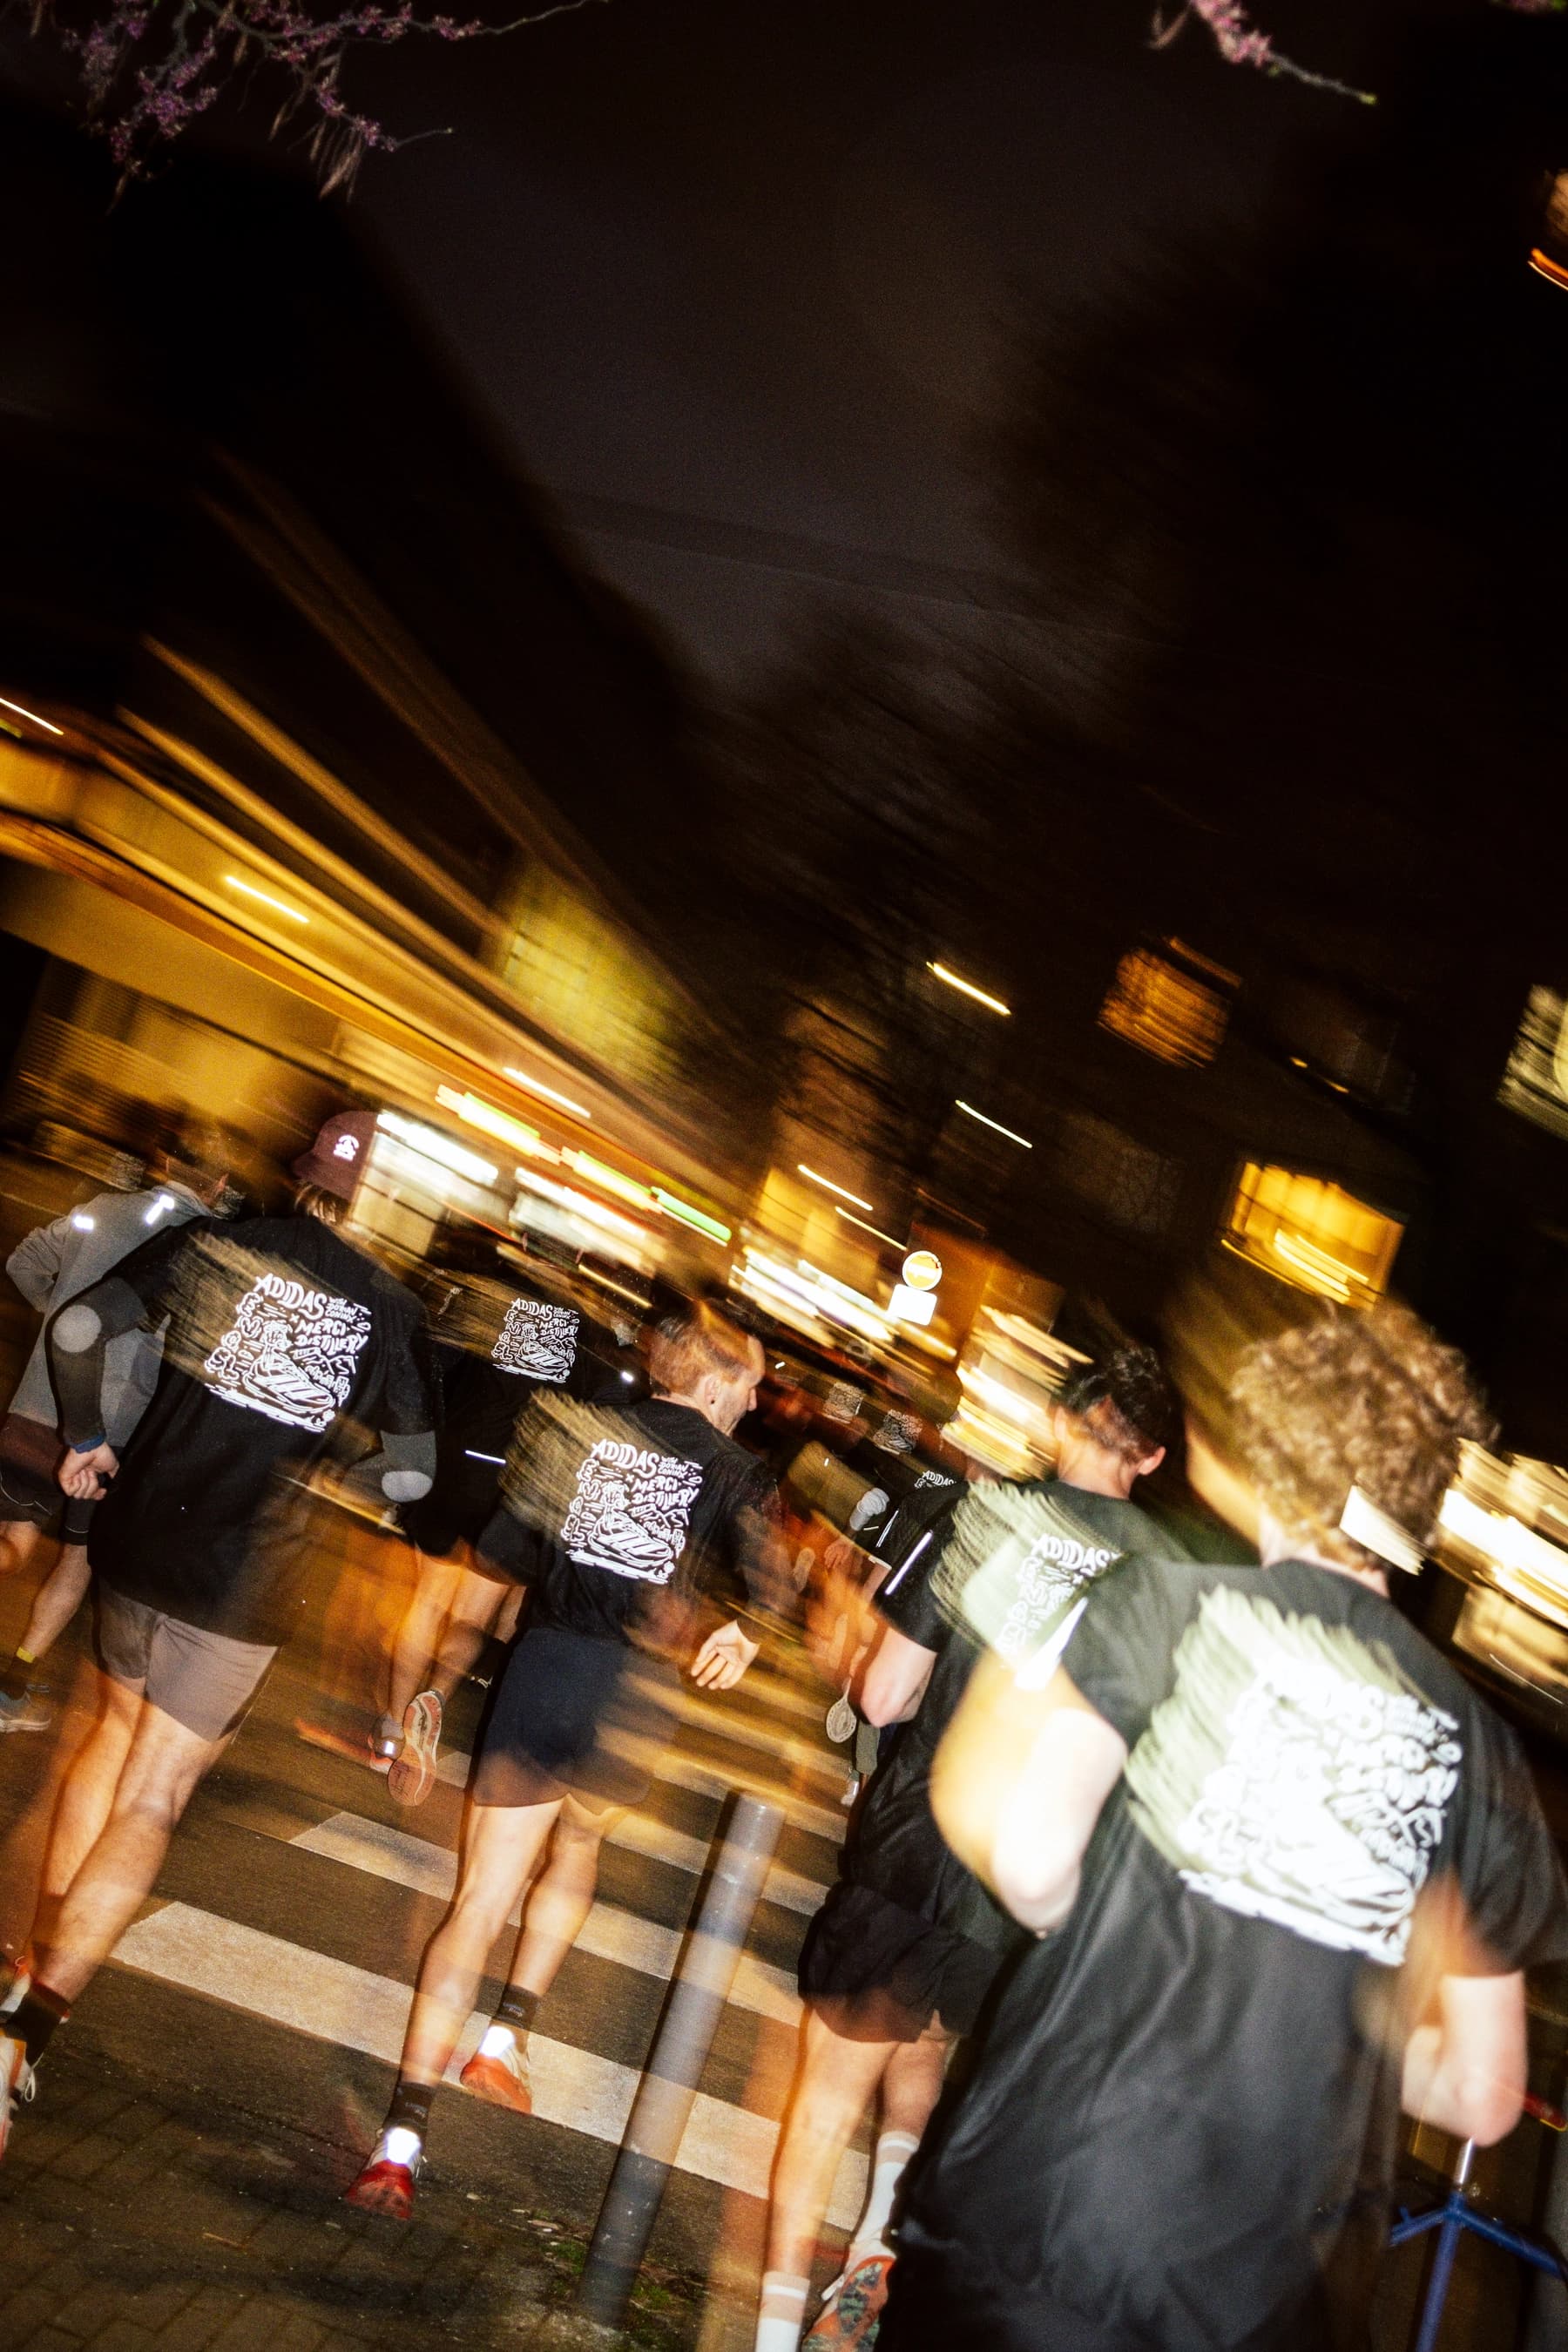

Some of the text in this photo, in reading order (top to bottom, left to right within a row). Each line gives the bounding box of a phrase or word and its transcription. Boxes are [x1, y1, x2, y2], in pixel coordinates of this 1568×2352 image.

[253, 1273, 328, 1320] ADIDAS
[510, 1298, 553, 1321] ADIDAS
[294, 1318, 347, 1336] MERCI
[539, 1318, 567, 1330] MERCI
[294, 1333, 369, 1355] DISTILLERY
[590, 1439, 659, 1478] ADIDAS
[631, 1475, 678, 1492] MERCI
[632, 1488, 700, 1511] DISTILLERY
